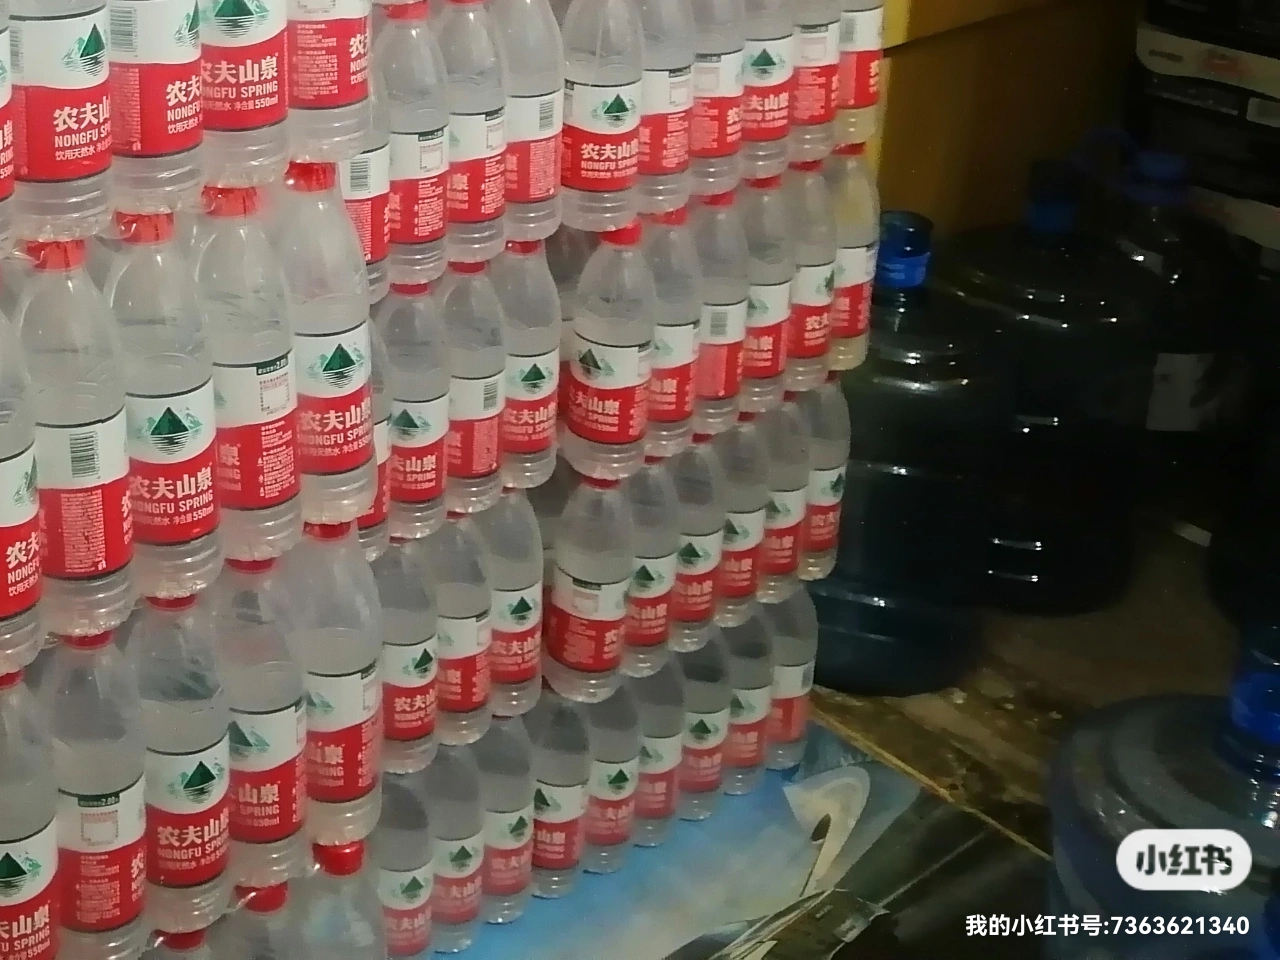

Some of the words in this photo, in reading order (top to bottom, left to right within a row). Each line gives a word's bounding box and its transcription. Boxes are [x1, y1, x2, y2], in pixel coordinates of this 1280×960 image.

[241, 81, 278, 98] SPRING
[167, 99, 200, 122] NONGFU
[54, 128, 98, 148] NONGFU
[55, 146, 95, 161] 饮用天然水
[581, 160, 615, 170] NONGFU
[130, 468, 212, 500] 农夫山泉
[179, 492, 213, 512] SPRING
[240, 804, 279, 816] SPRING
[14, 926, 50, 951] SPRING
